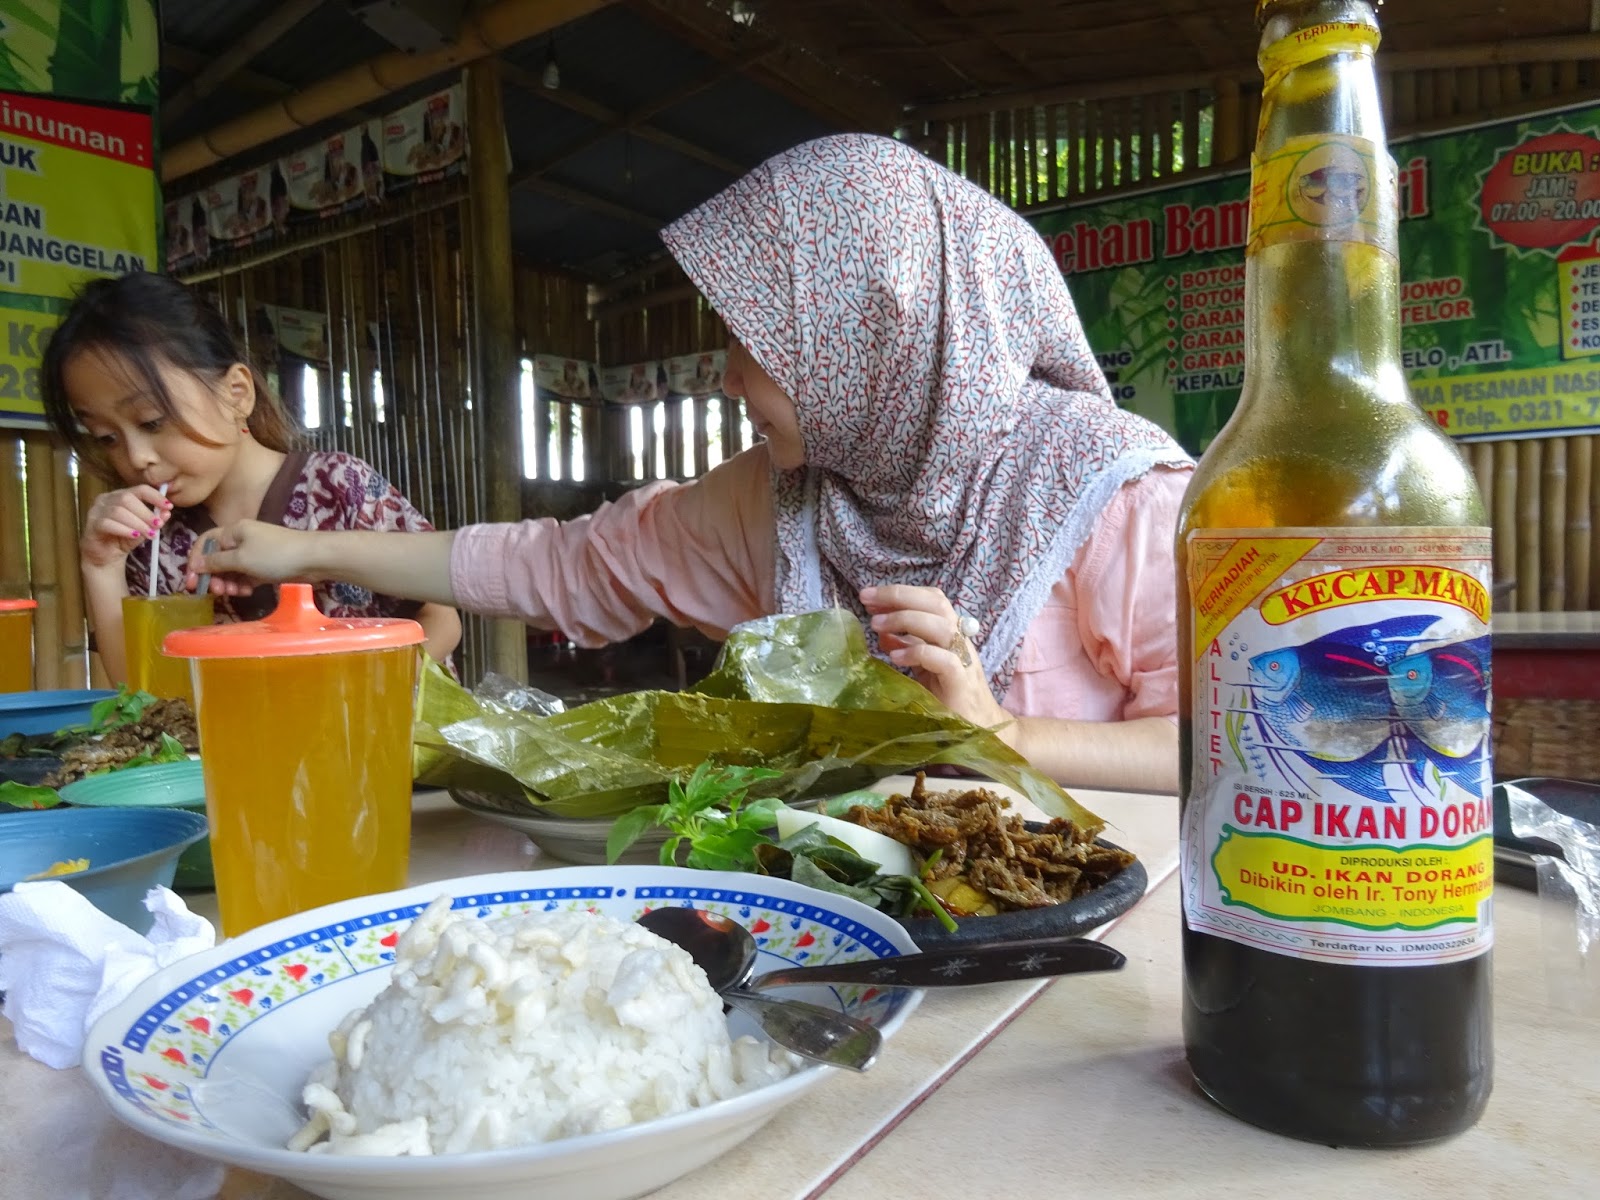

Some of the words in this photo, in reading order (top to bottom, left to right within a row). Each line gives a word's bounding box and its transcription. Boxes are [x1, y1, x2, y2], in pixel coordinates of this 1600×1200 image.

[2, 101, 125, 155] inuman
[1512, 151, 1584, 175] BUKA
[1400, 157, 1427, 220] i
[1492, 203, 1539, 222] 07.00
[1555, 200, 1600, 220] 20.00
[1045, 221, 1154, 273] ehan
[1451, 376, 1547, 403] PESANAN
[1508, 399, 1563, 423] 0321
[1200, 547, 1260, 618] BERHADIAH
[1278, 569, 1406, 617] KECAP
[1413, 569, 1485, 617] MANIS
[1244, 785, 1273, 796] BERSIH
[1279, 790, 1296, 799] 625
[1234, 792, 1303, 832] CAP
[1314, 802, 1407, 840] IKAN
[1272, 861, 1316, 880] UD.
[1325, 869, 1393, 884] IKAN
[1407, 862, 1486, 884] DORANG
[1341, 856, 1413, 868] DIPRODUKSI
[1415, 857, 1443, 868] OLEH
[1240, 868, 1306, 896] Dibikin
[1313, 883, 1359, 901] oleh
[1367, 886, 1385, 902] Ir.
[1391, 886, 1438, 904] Tony
[1313, 904, 1386, 918] JOMBANG
[1400, 904, 1465, 917] INDONESIA
[1310, 939, 1372, 953] Terdaftar
[1375, 944, 1397, 954] No.
